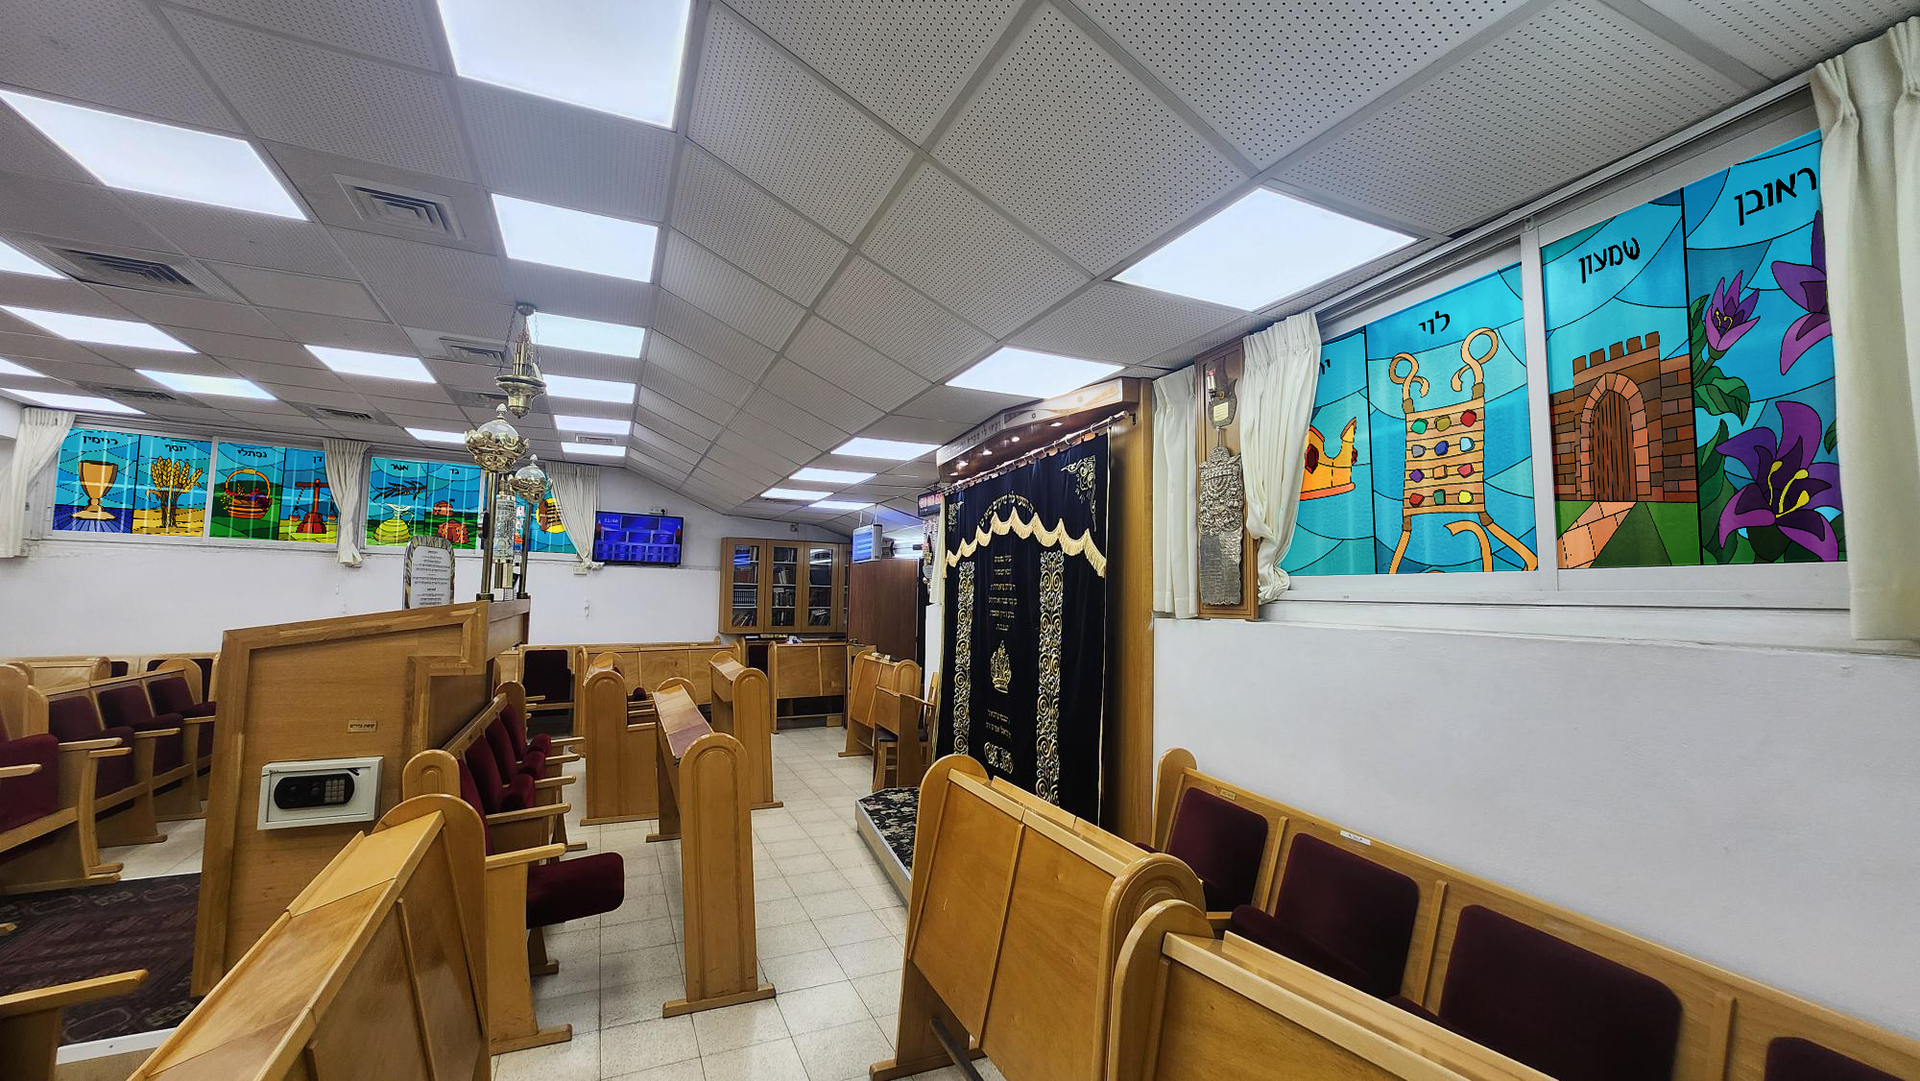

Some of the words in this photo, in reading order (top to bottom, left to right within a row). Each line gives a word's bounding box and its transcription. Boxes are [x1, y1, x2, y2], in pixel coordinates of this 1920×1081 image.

[1734, 167, 1817, 226] ראובן
[1578, 237, 1640, 284] שמעון
[1418, 310, 1450, 335] לוי
[83, 436, 118, 445] בנימין
[165, 444, 187, 452] יוסף
[237, 448, 267, 458] נפתלי
[313, 456, 323, 464] דן
[390, 463, 409, 471] אשר
